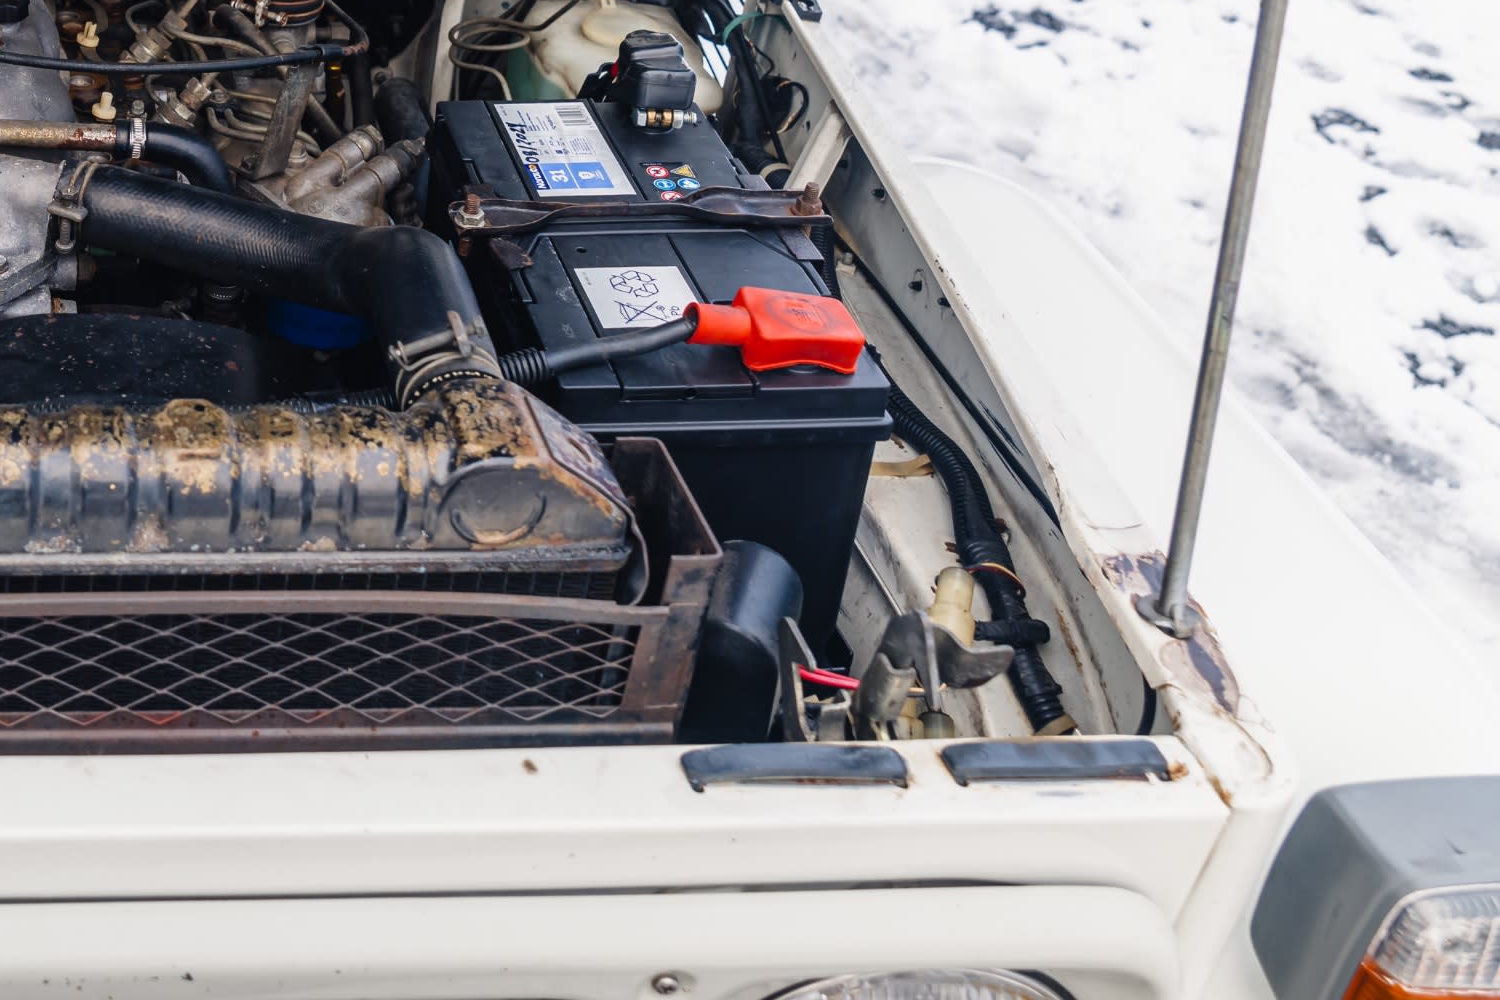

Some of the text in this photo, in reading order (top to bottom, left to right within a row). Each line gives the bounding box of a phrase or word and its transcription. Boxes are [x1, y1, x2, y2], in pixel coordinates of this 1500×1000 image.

[505, 121, 540, 163] 08/2024
[528, 164, 547, 189] Norauto
[549, 169, 569, 183] 31
